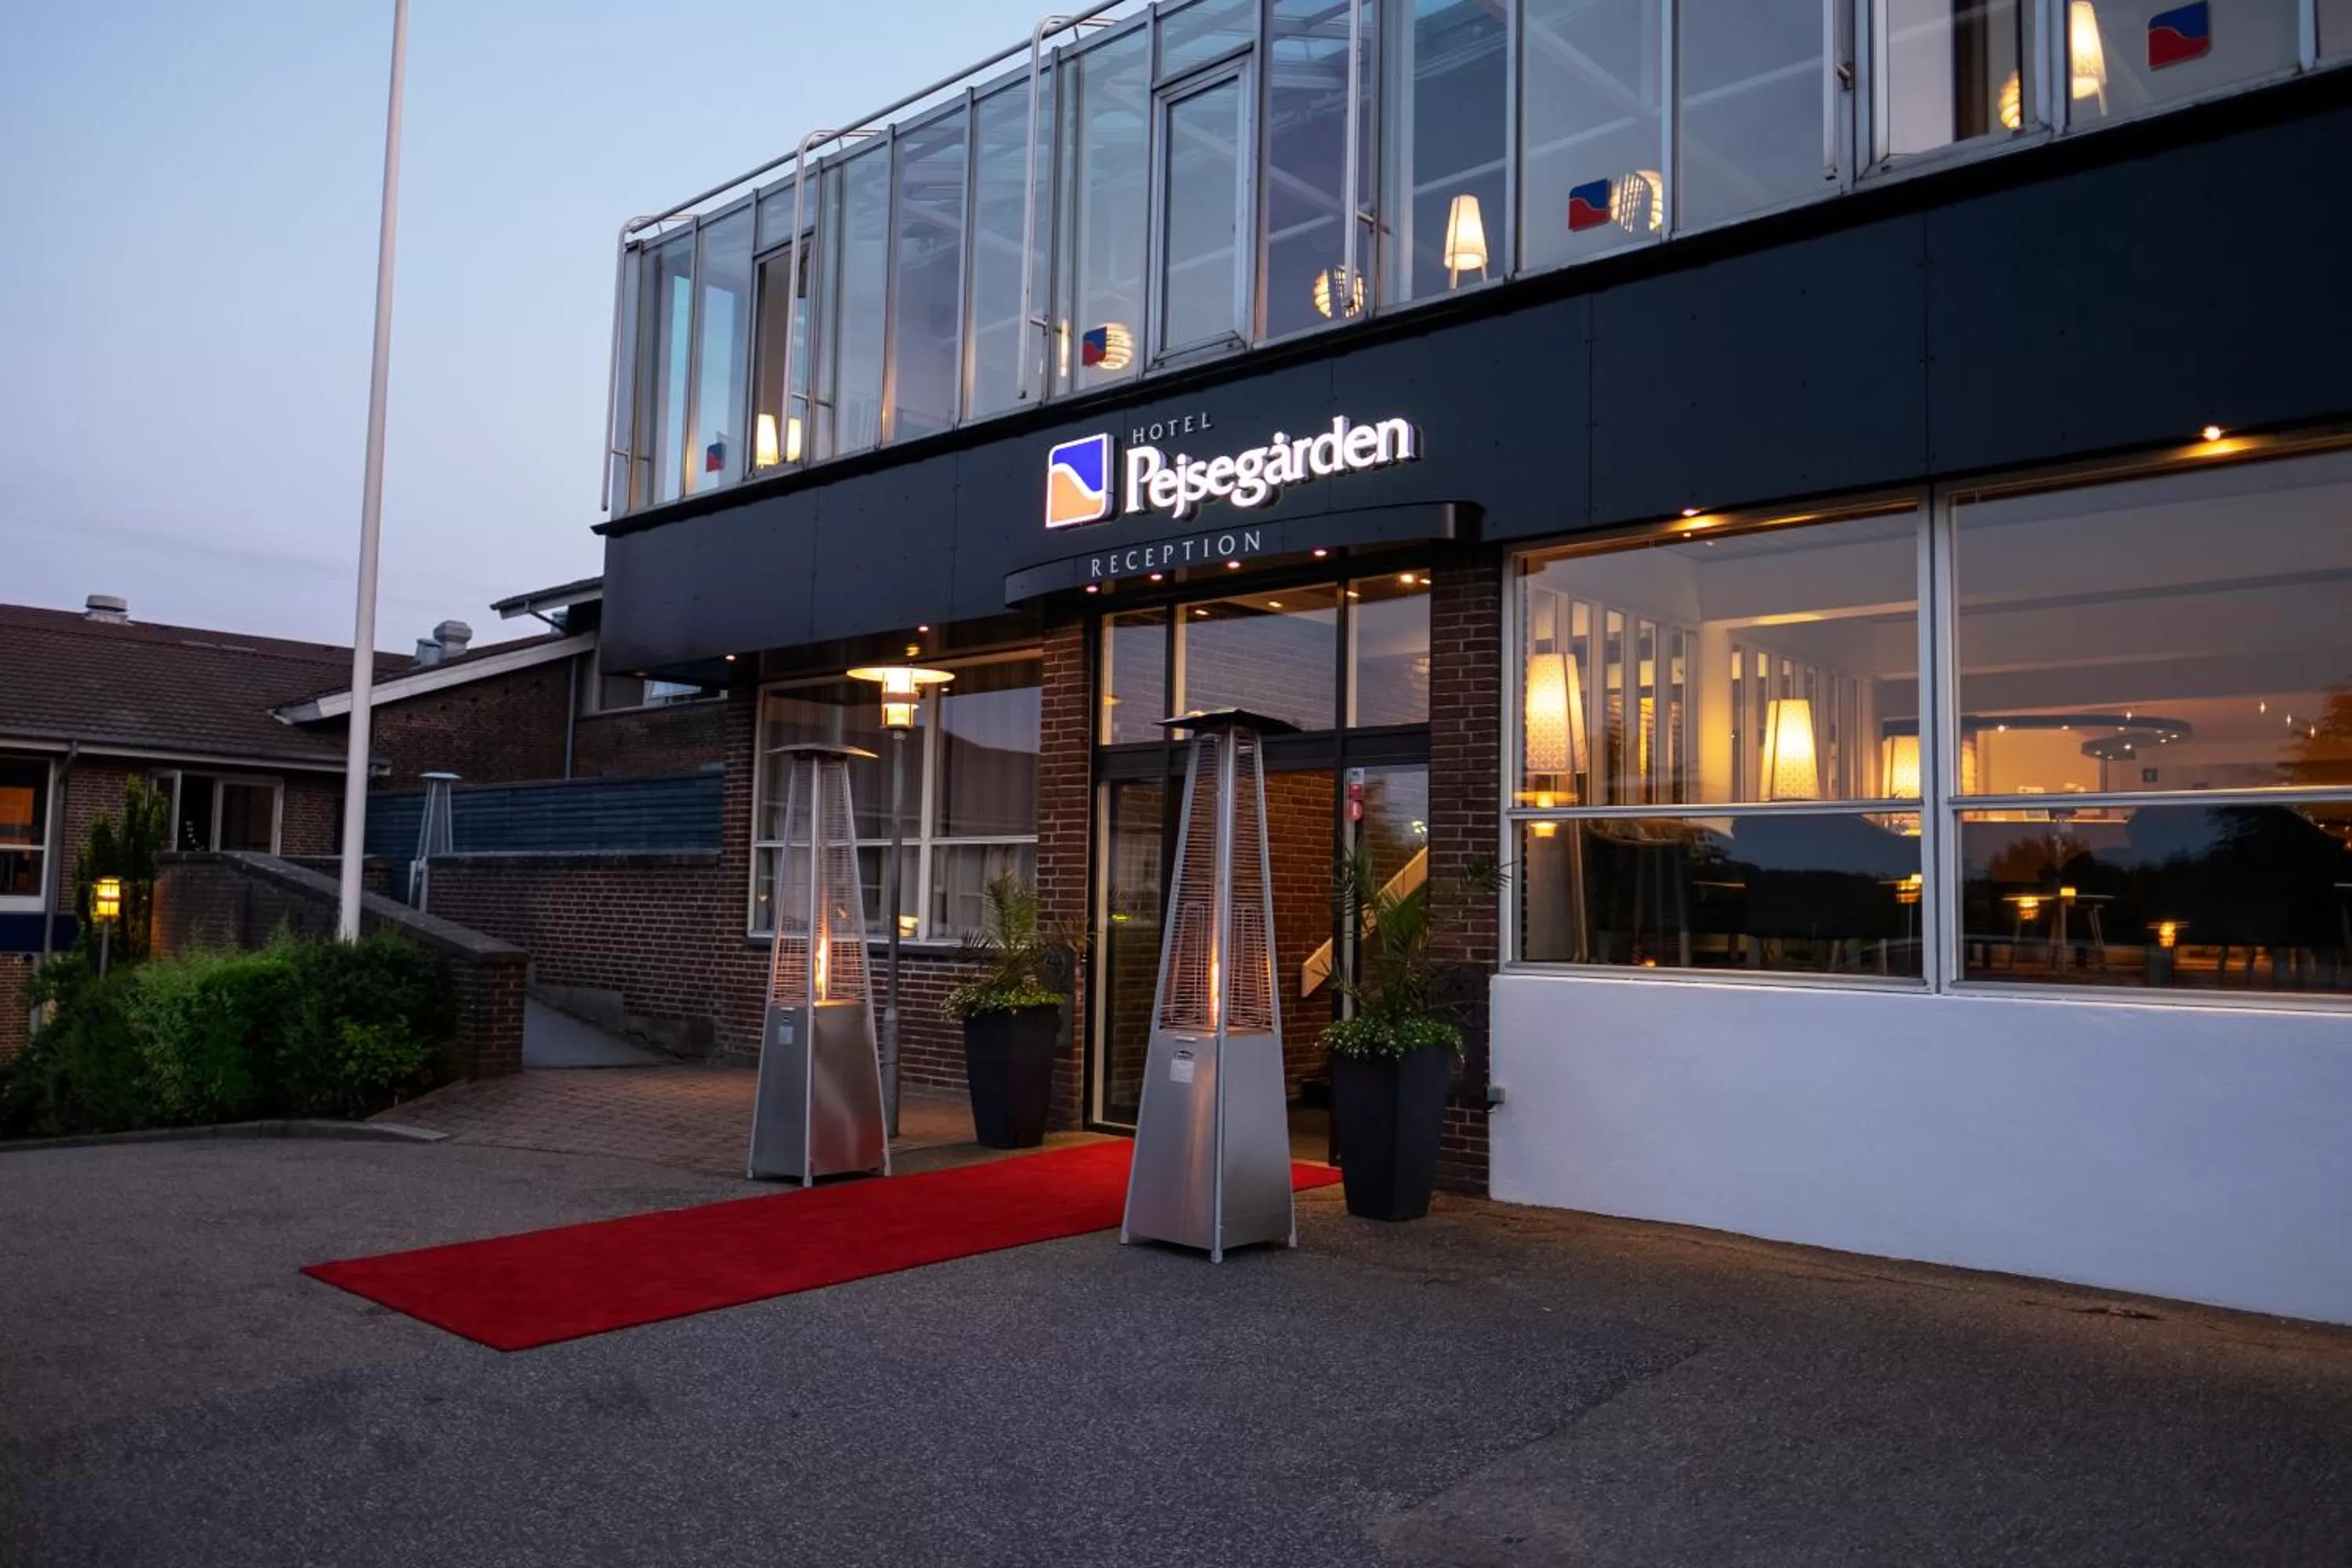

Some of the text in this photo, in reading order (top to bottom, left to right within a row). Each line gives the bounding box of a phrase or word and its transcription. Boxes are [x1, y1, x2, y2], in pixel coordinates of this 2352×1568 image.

[1133, 412, 1213, 444] HOTEL
[1124, 415, 1414, 518] Pejsegården
[1091, 531, 1261, 577] RECEPTION
